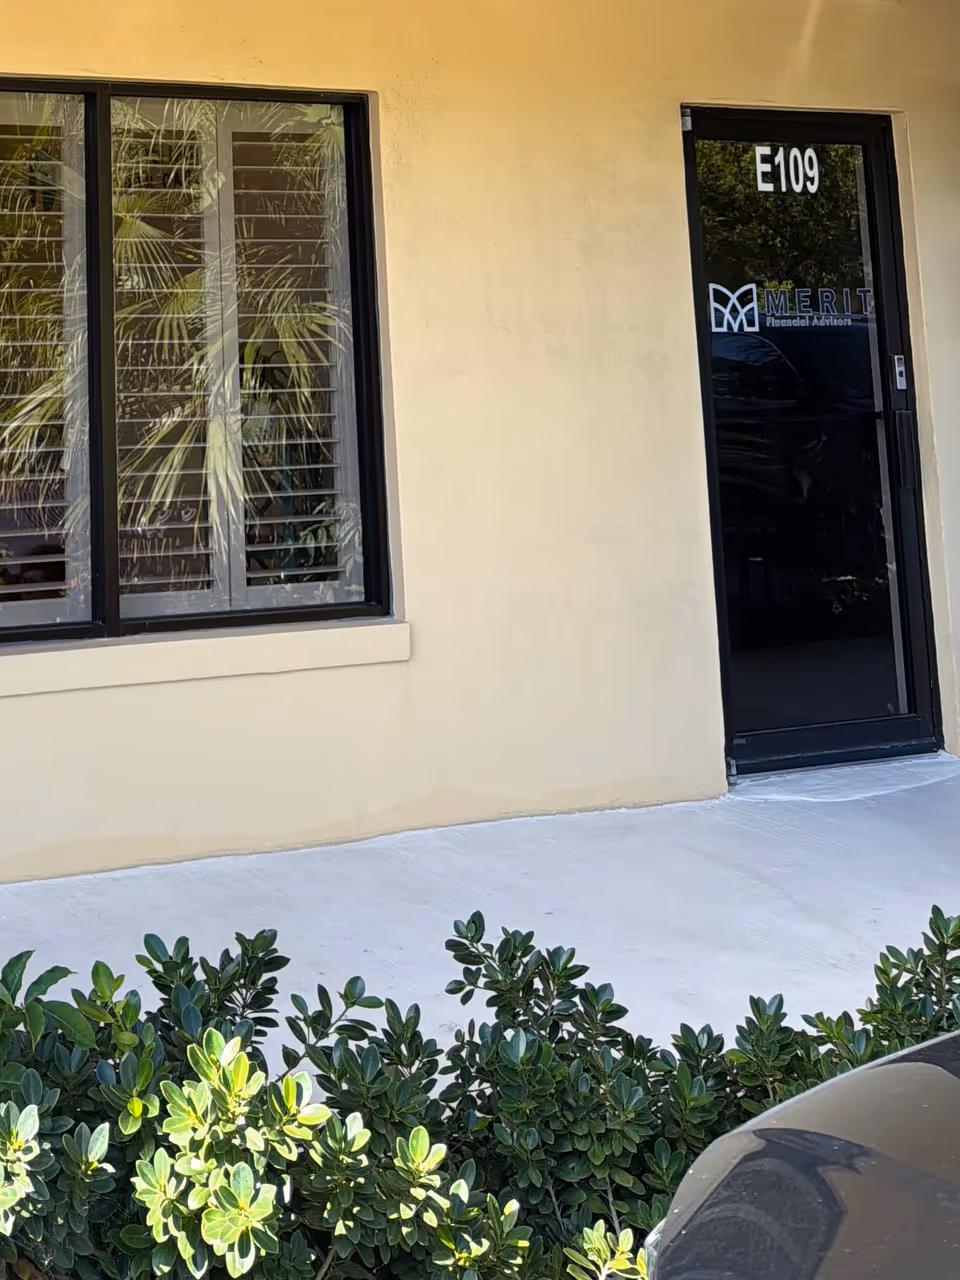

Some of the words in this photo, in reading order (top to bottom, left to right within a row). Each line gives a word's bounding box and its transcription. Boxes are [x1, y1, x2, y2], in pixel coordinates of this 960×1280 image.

[755, 146, 819, 194] E109
[764, 288, 873, 316] MERIT
[766, 316, 810, 328] Financial
[812, 316, 853, 328] Advisors
